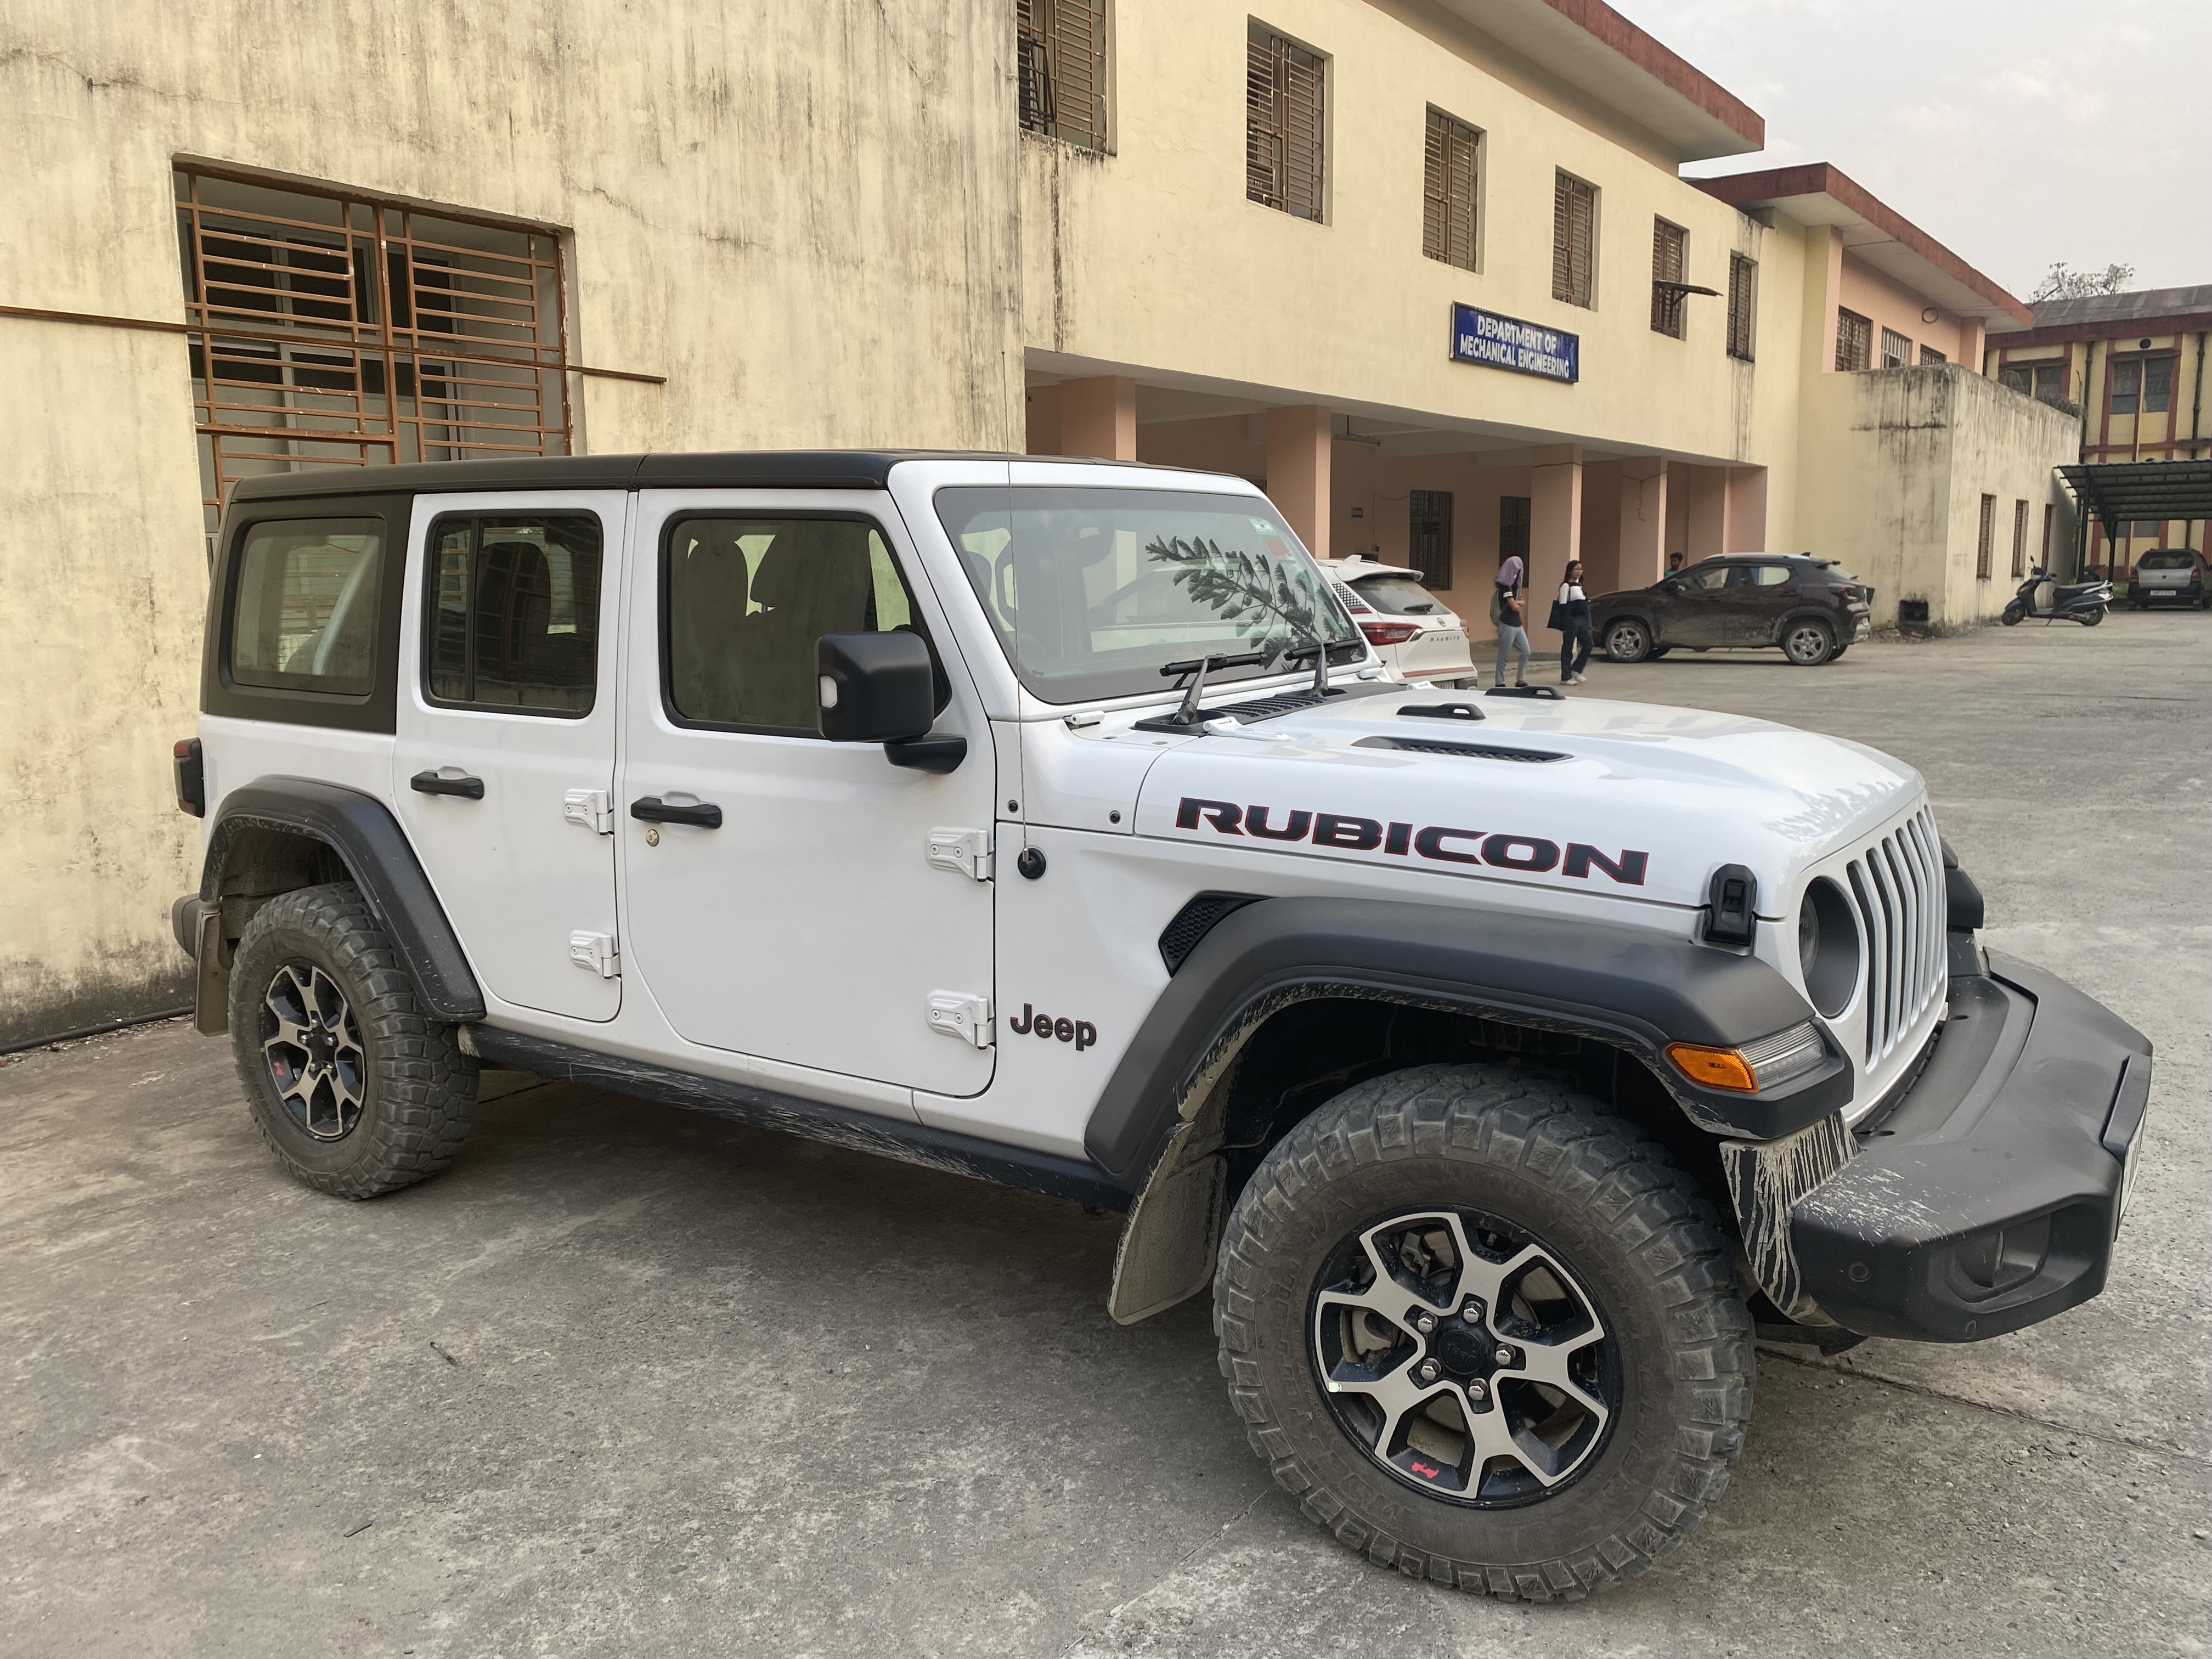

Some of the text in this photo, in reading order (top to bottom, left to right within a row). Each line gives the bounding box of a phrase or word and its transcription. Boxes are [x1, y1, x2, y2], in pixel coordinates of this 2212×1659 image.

[1460, 334, 1569, 378] MECHANICAL ENGINEERING
[1477, 315, 1556, 353] DEPARTMENT OF
[1176, 797, 1649, 885] RUBICON
[1010, 1003, 1097, 1051] Jeep
